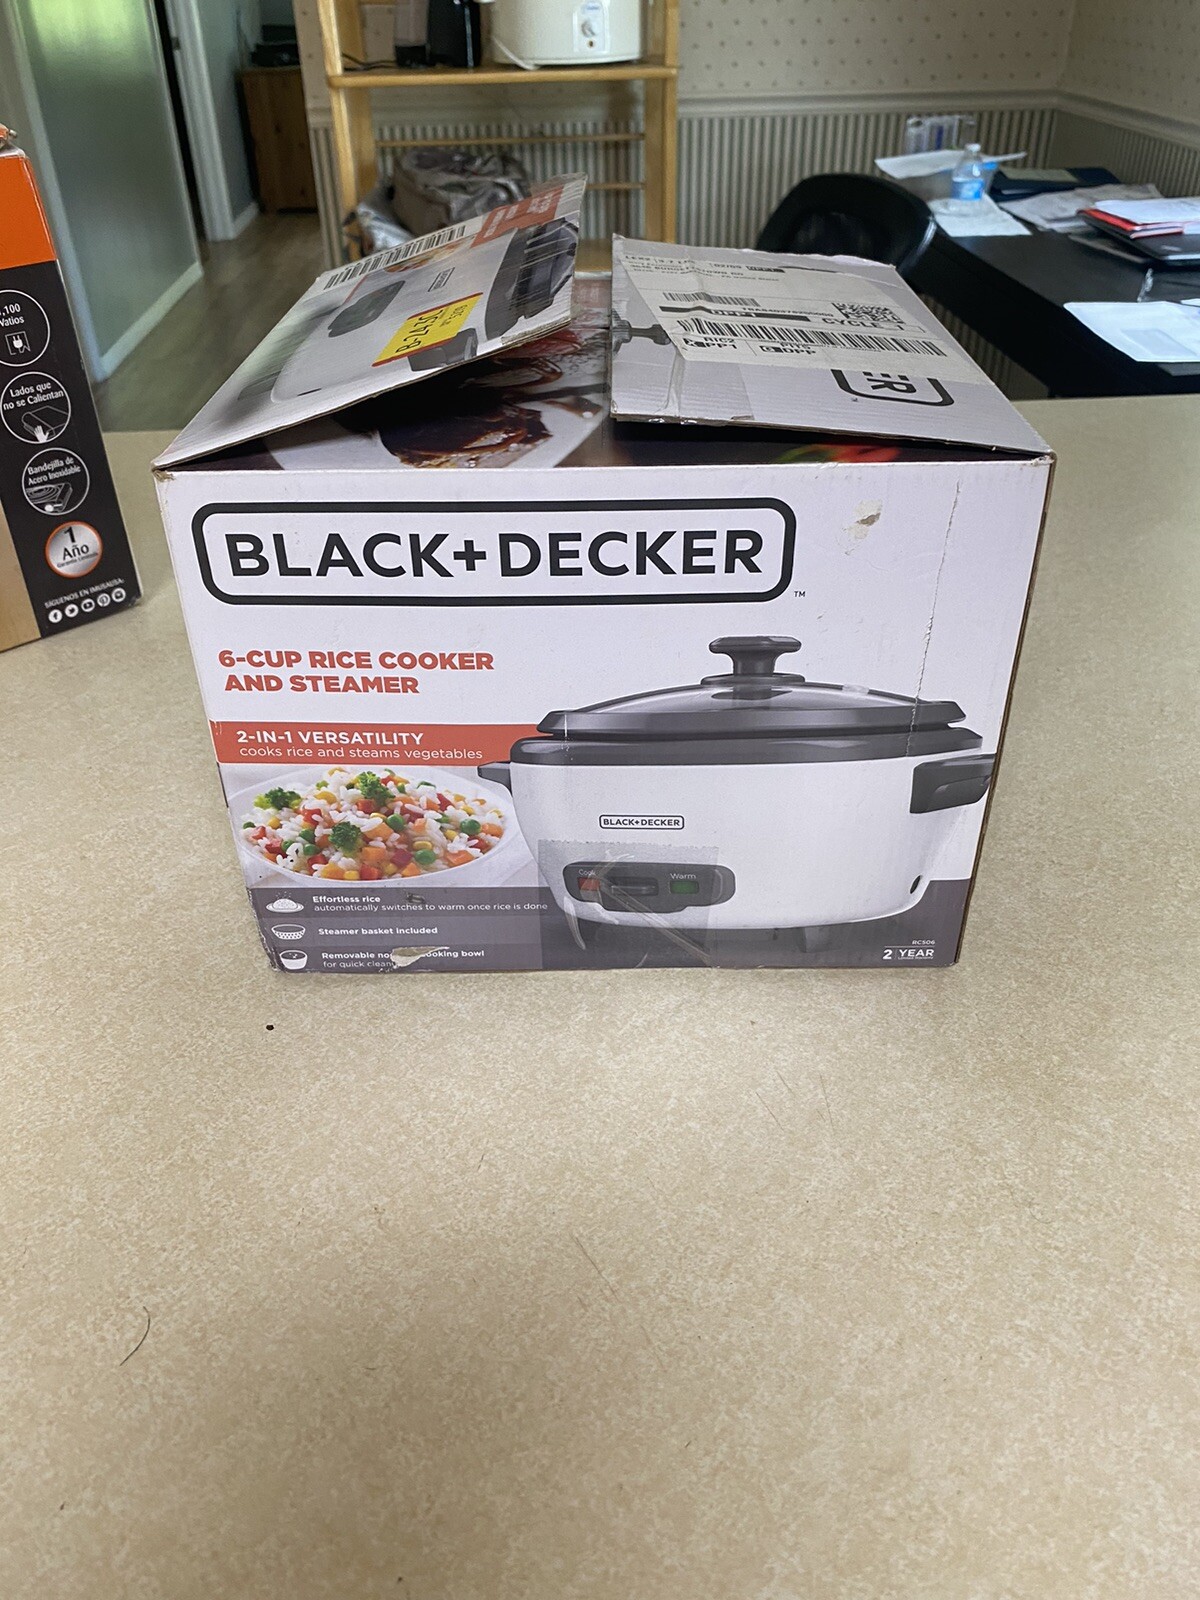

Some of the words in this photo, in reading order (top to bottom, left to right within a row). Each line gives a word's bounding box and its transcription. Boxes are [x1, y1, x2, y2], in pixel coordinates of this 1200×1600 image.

[0, 303, 21, 316] ,100
[822, 318, 884, 329] CYCLE
[10, 385, 35, 398] Lados
[36, 382, 52, 393] que
[3, 401, 14, 411] no
[17, 398, 26, 407] se
[27, 389, 64, 405] Calientan
[65, 456, 75, 465] de
[28, 475, 48, 486] Acero
[48, 465, 81, 480] Inoxidable
[64, 526, 76, 543] 1
[63, 544, 89, 561] Año
[218, 649, 302, 668] 6-CUP
[308, 650, 373, 669] RICE
[378, 651, 495, 670] COOKER
[224, 674, 283, 692] AND
[289, 674, 420, 694] STEAMER
[236, 730, 293, 743] 2-IN-1
[297, 731, 424, 745] VERSATILITY
[240, 746, 282, 757] cooks
[287, 746, 313, 757] rice
[317, 747, 345, 757] and
[349, 748, 400, 758] steams
[404, 748, 483, 760] vegetables
[602, 818, 680, 827] BLACK+DECKER
[312, 895, 360, 903] Effortless
[362, 895, 381, 903] rice
[314, 904, 379, 912] automatically
[381, 903, 423, 911] switches
[493, 903, 511, 911] rice
[523, 902, 548, 910] done
[361, 927, 394, 935] basket
[396, 926, 438, 935] included
[882, 948, 893, 960] 2
[898, 948, 935, 957] YEAR
[323, 960, 337, 968] for
[339, 960, 365, 968] quick
